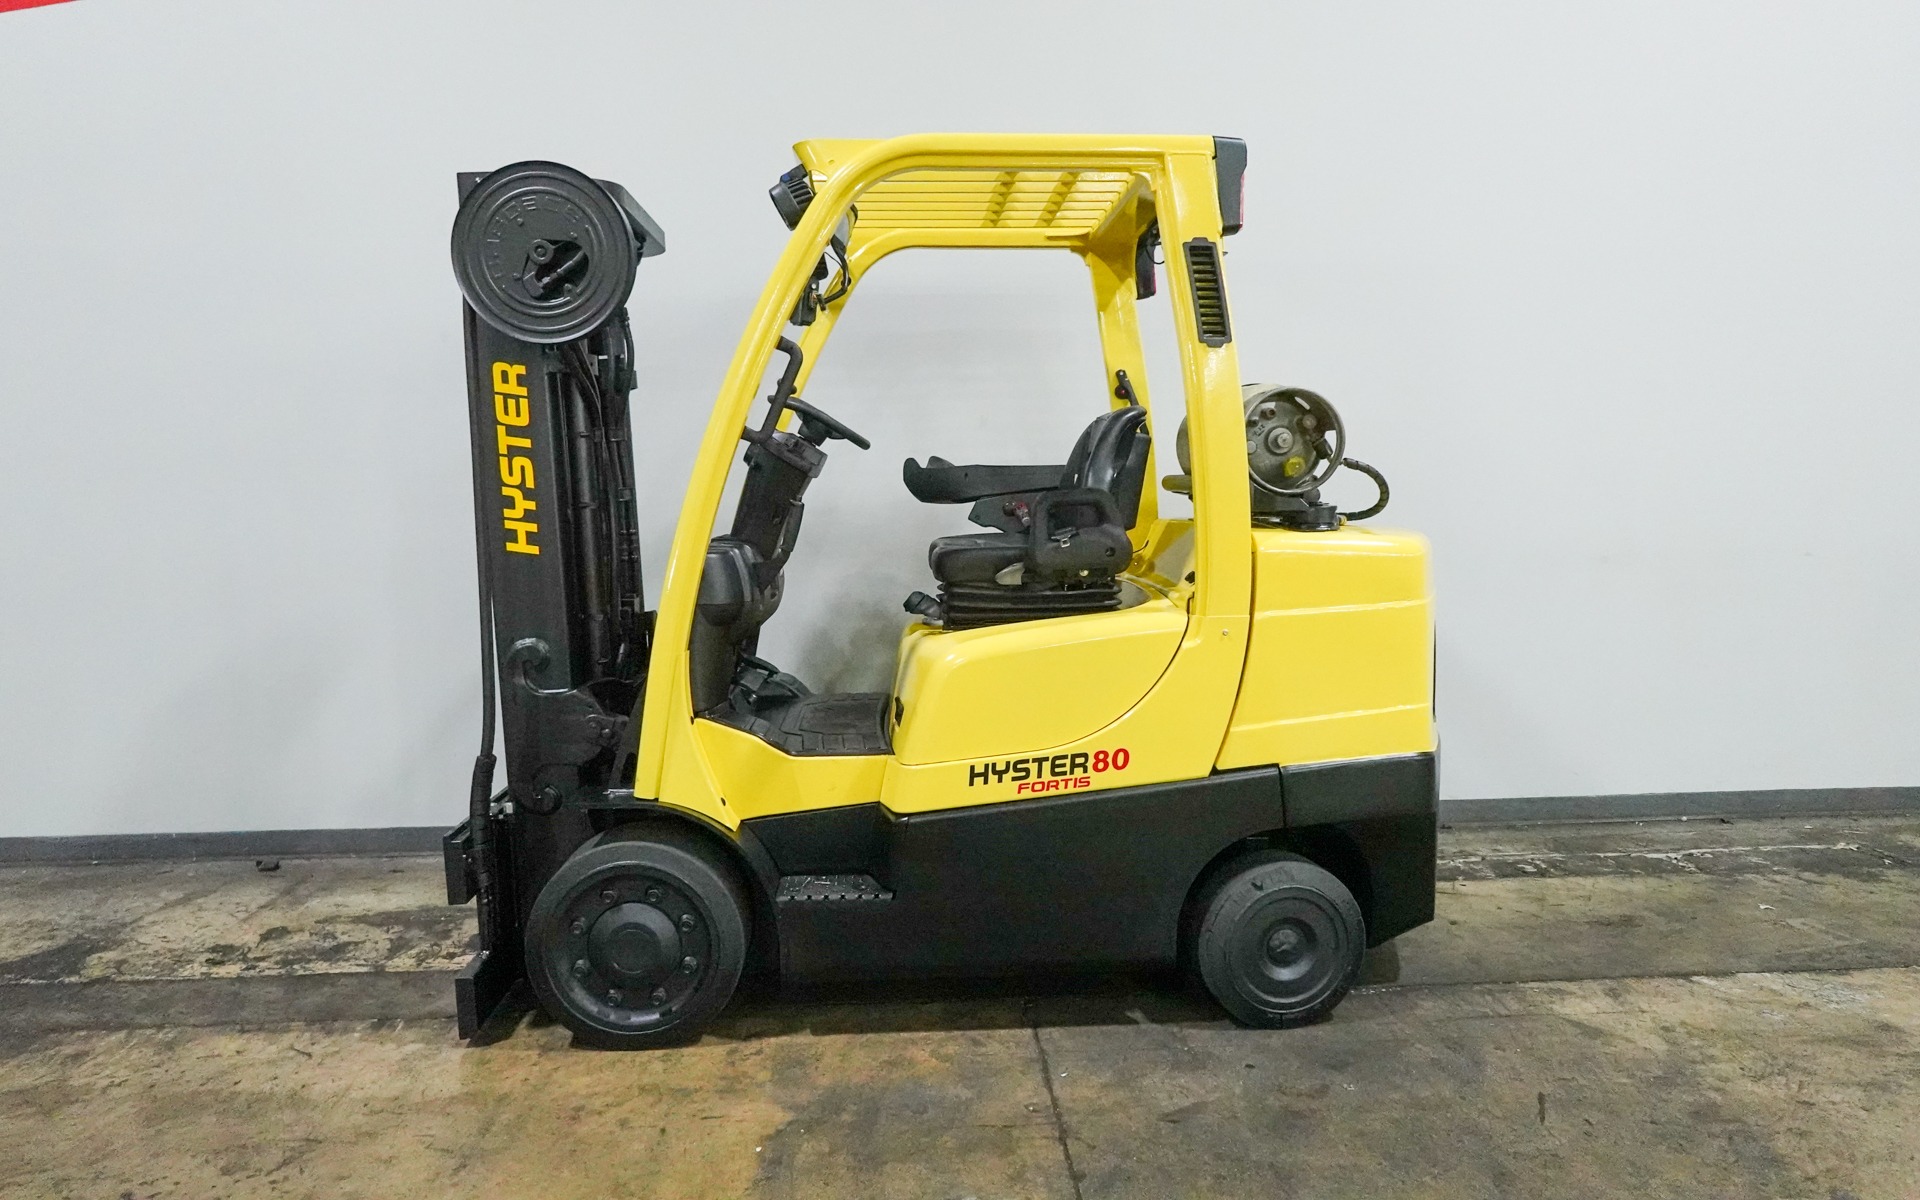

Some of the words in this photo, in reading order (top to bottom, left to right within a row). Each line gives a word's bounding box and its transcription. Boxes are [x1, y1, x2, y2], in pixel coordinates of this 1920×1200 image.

[492, 361, 540, 555] HYSTER
[968, 752, 1089, 787] HYSTER
[1092, 748, 1130, 773] 80
[1017, 776, 1091, 794] FORTIS
